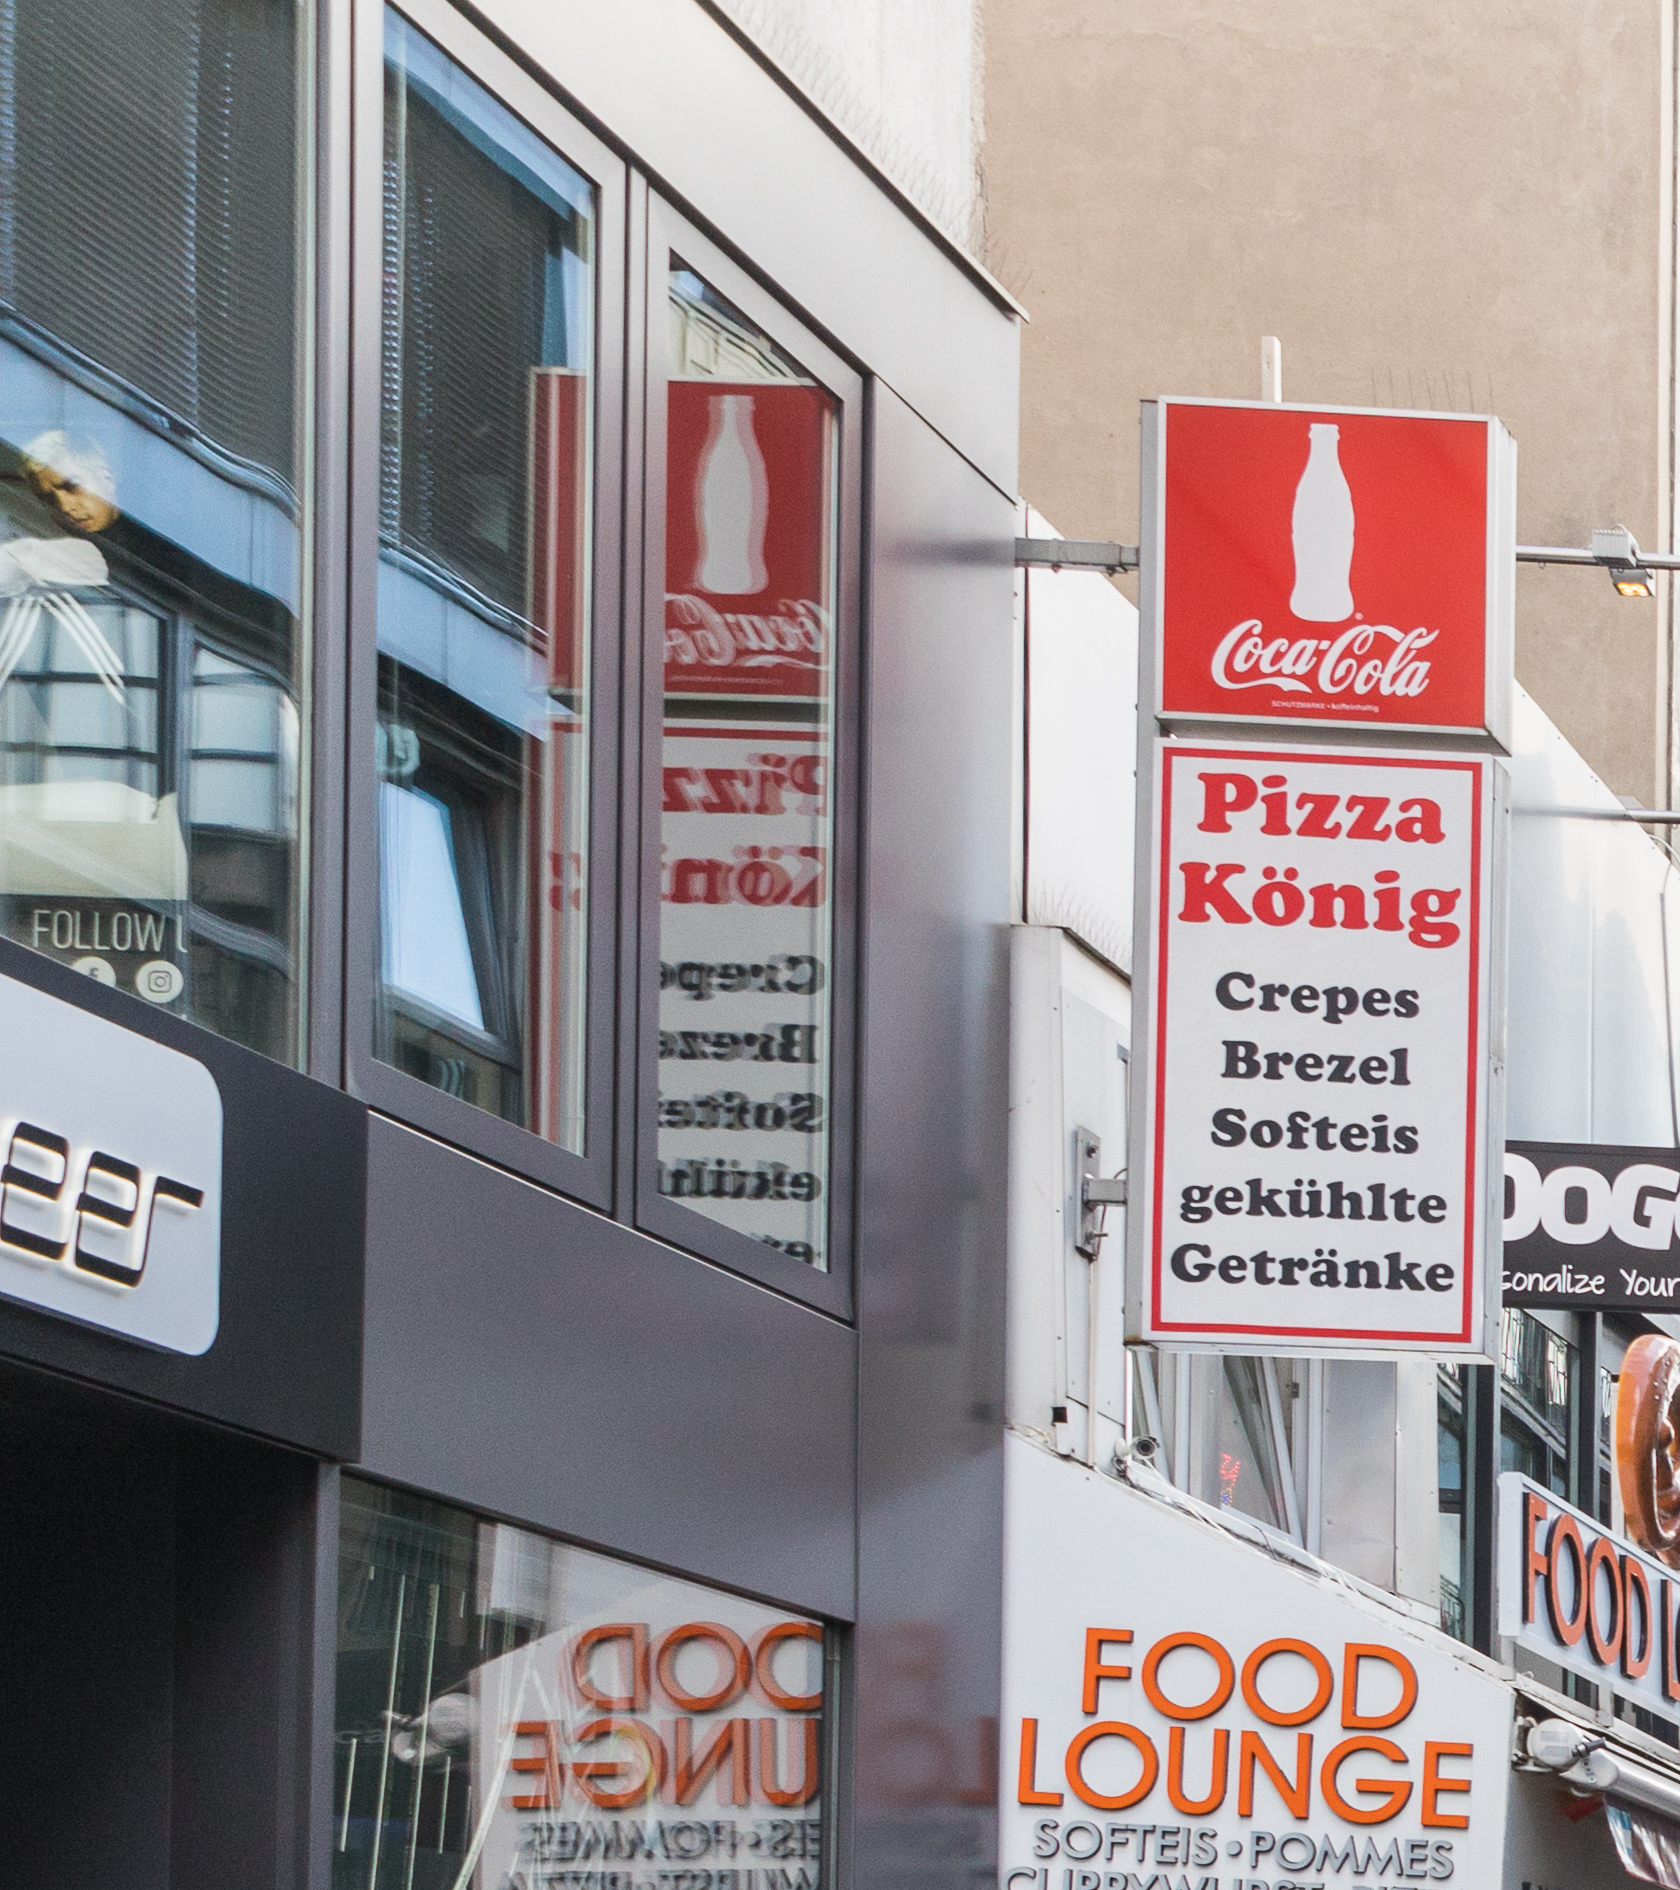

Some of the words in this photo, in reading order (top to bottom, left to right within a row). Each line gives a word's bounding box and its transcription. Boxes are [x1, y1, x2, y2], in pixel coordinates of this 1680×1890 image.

[1211, 619, 1440, 697] Coca-Cola
[1197, 772, 1446, 845] Pizza
[32, 909, 165, 952] FOLLOW
[1178, 861, 1462, 949] König
[1215, 972, 1420, 1024] Crepes
[1221, 1040, 1412, 1086] Brezel
[1211, 1108, 1419, 1154] Softeis
[1180, 1178, 1448, 1224] gekühlte
[1171, 1243, 1455, 1293] Getränke
[1523, 1491, 1653, 1681] FOOD
[1082, 1627, 1420, 1731] FOOD
[1016, 1718, 1475, 1831] LOUNGE
[1033, 1818, 1219, 1868] SOFTEIS
[1248, 1831, 1455, 1880] POMMES
